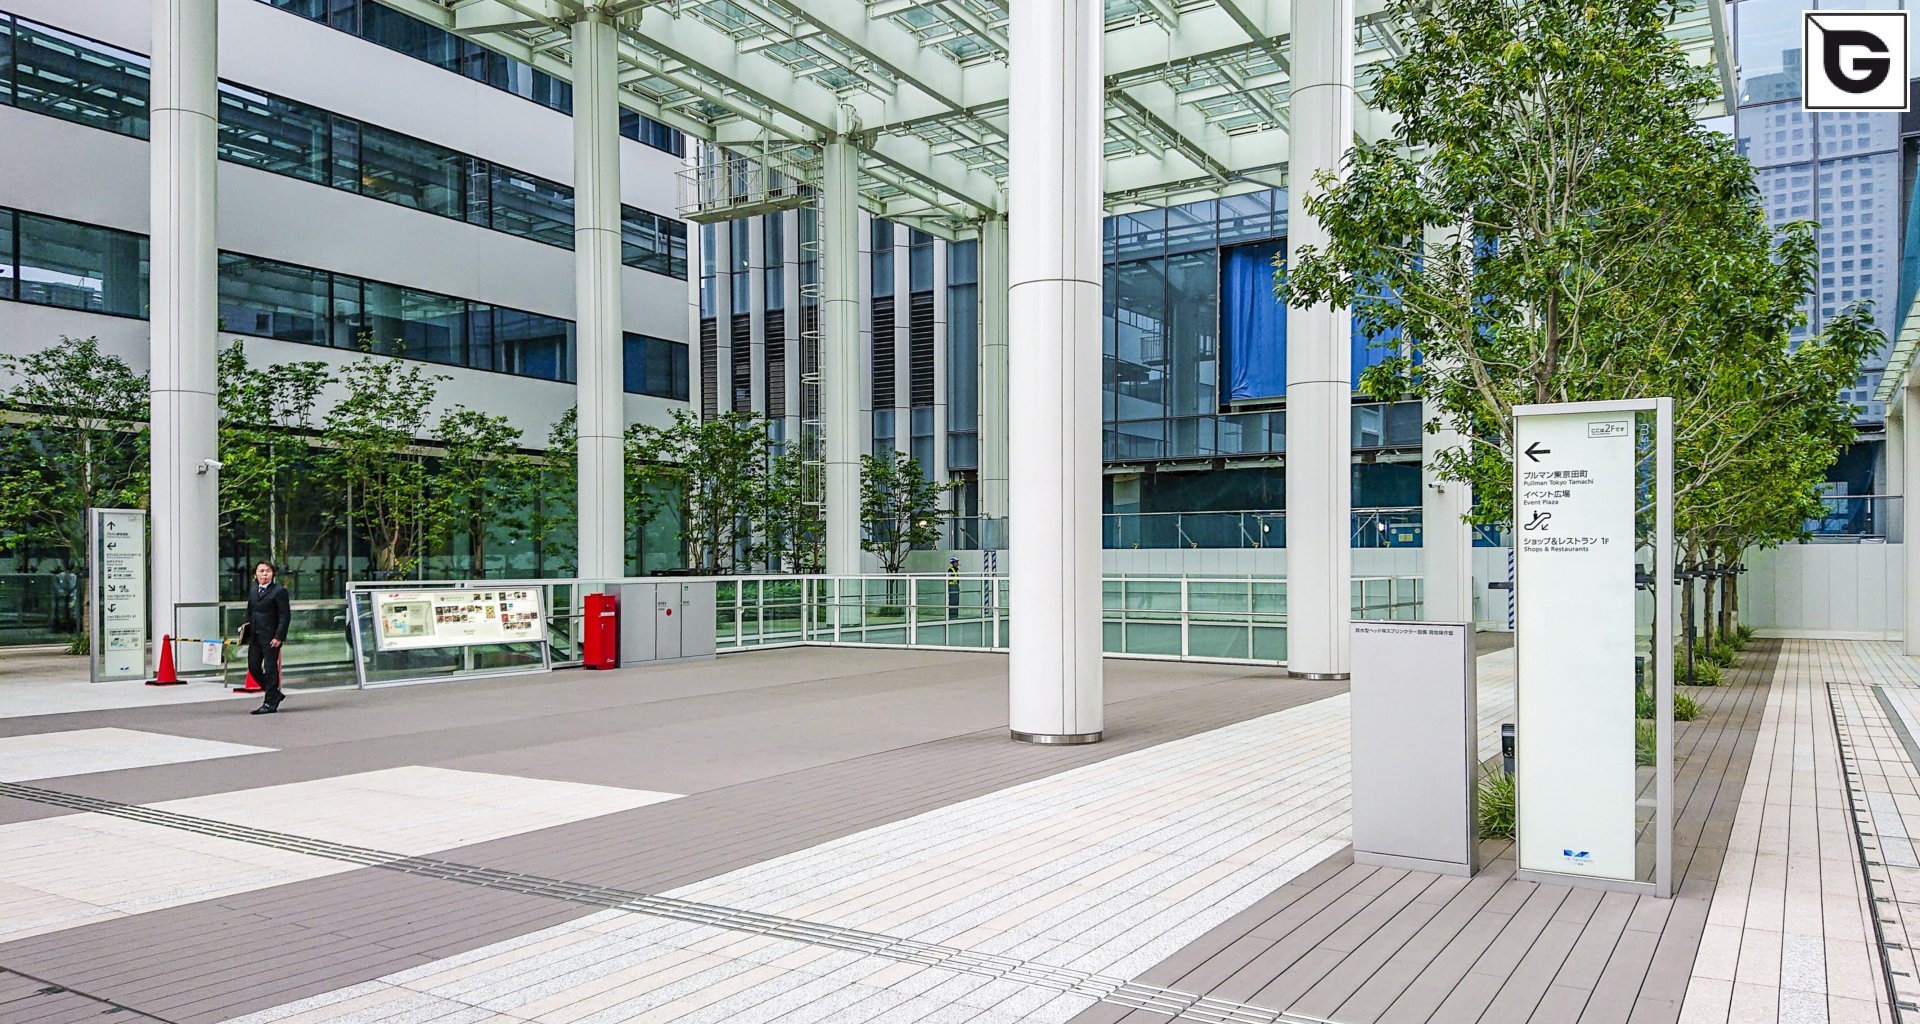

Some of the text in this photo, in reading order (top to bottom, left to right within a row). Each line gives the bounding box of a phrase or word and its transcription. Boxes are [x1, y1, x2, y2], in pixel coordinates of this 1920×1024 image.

[1523, 470, 1588, 480] プルマン東京田町
[1523, 489, 1571, 498] イベント広場
[1601, 537, 1610, 545] 1F
